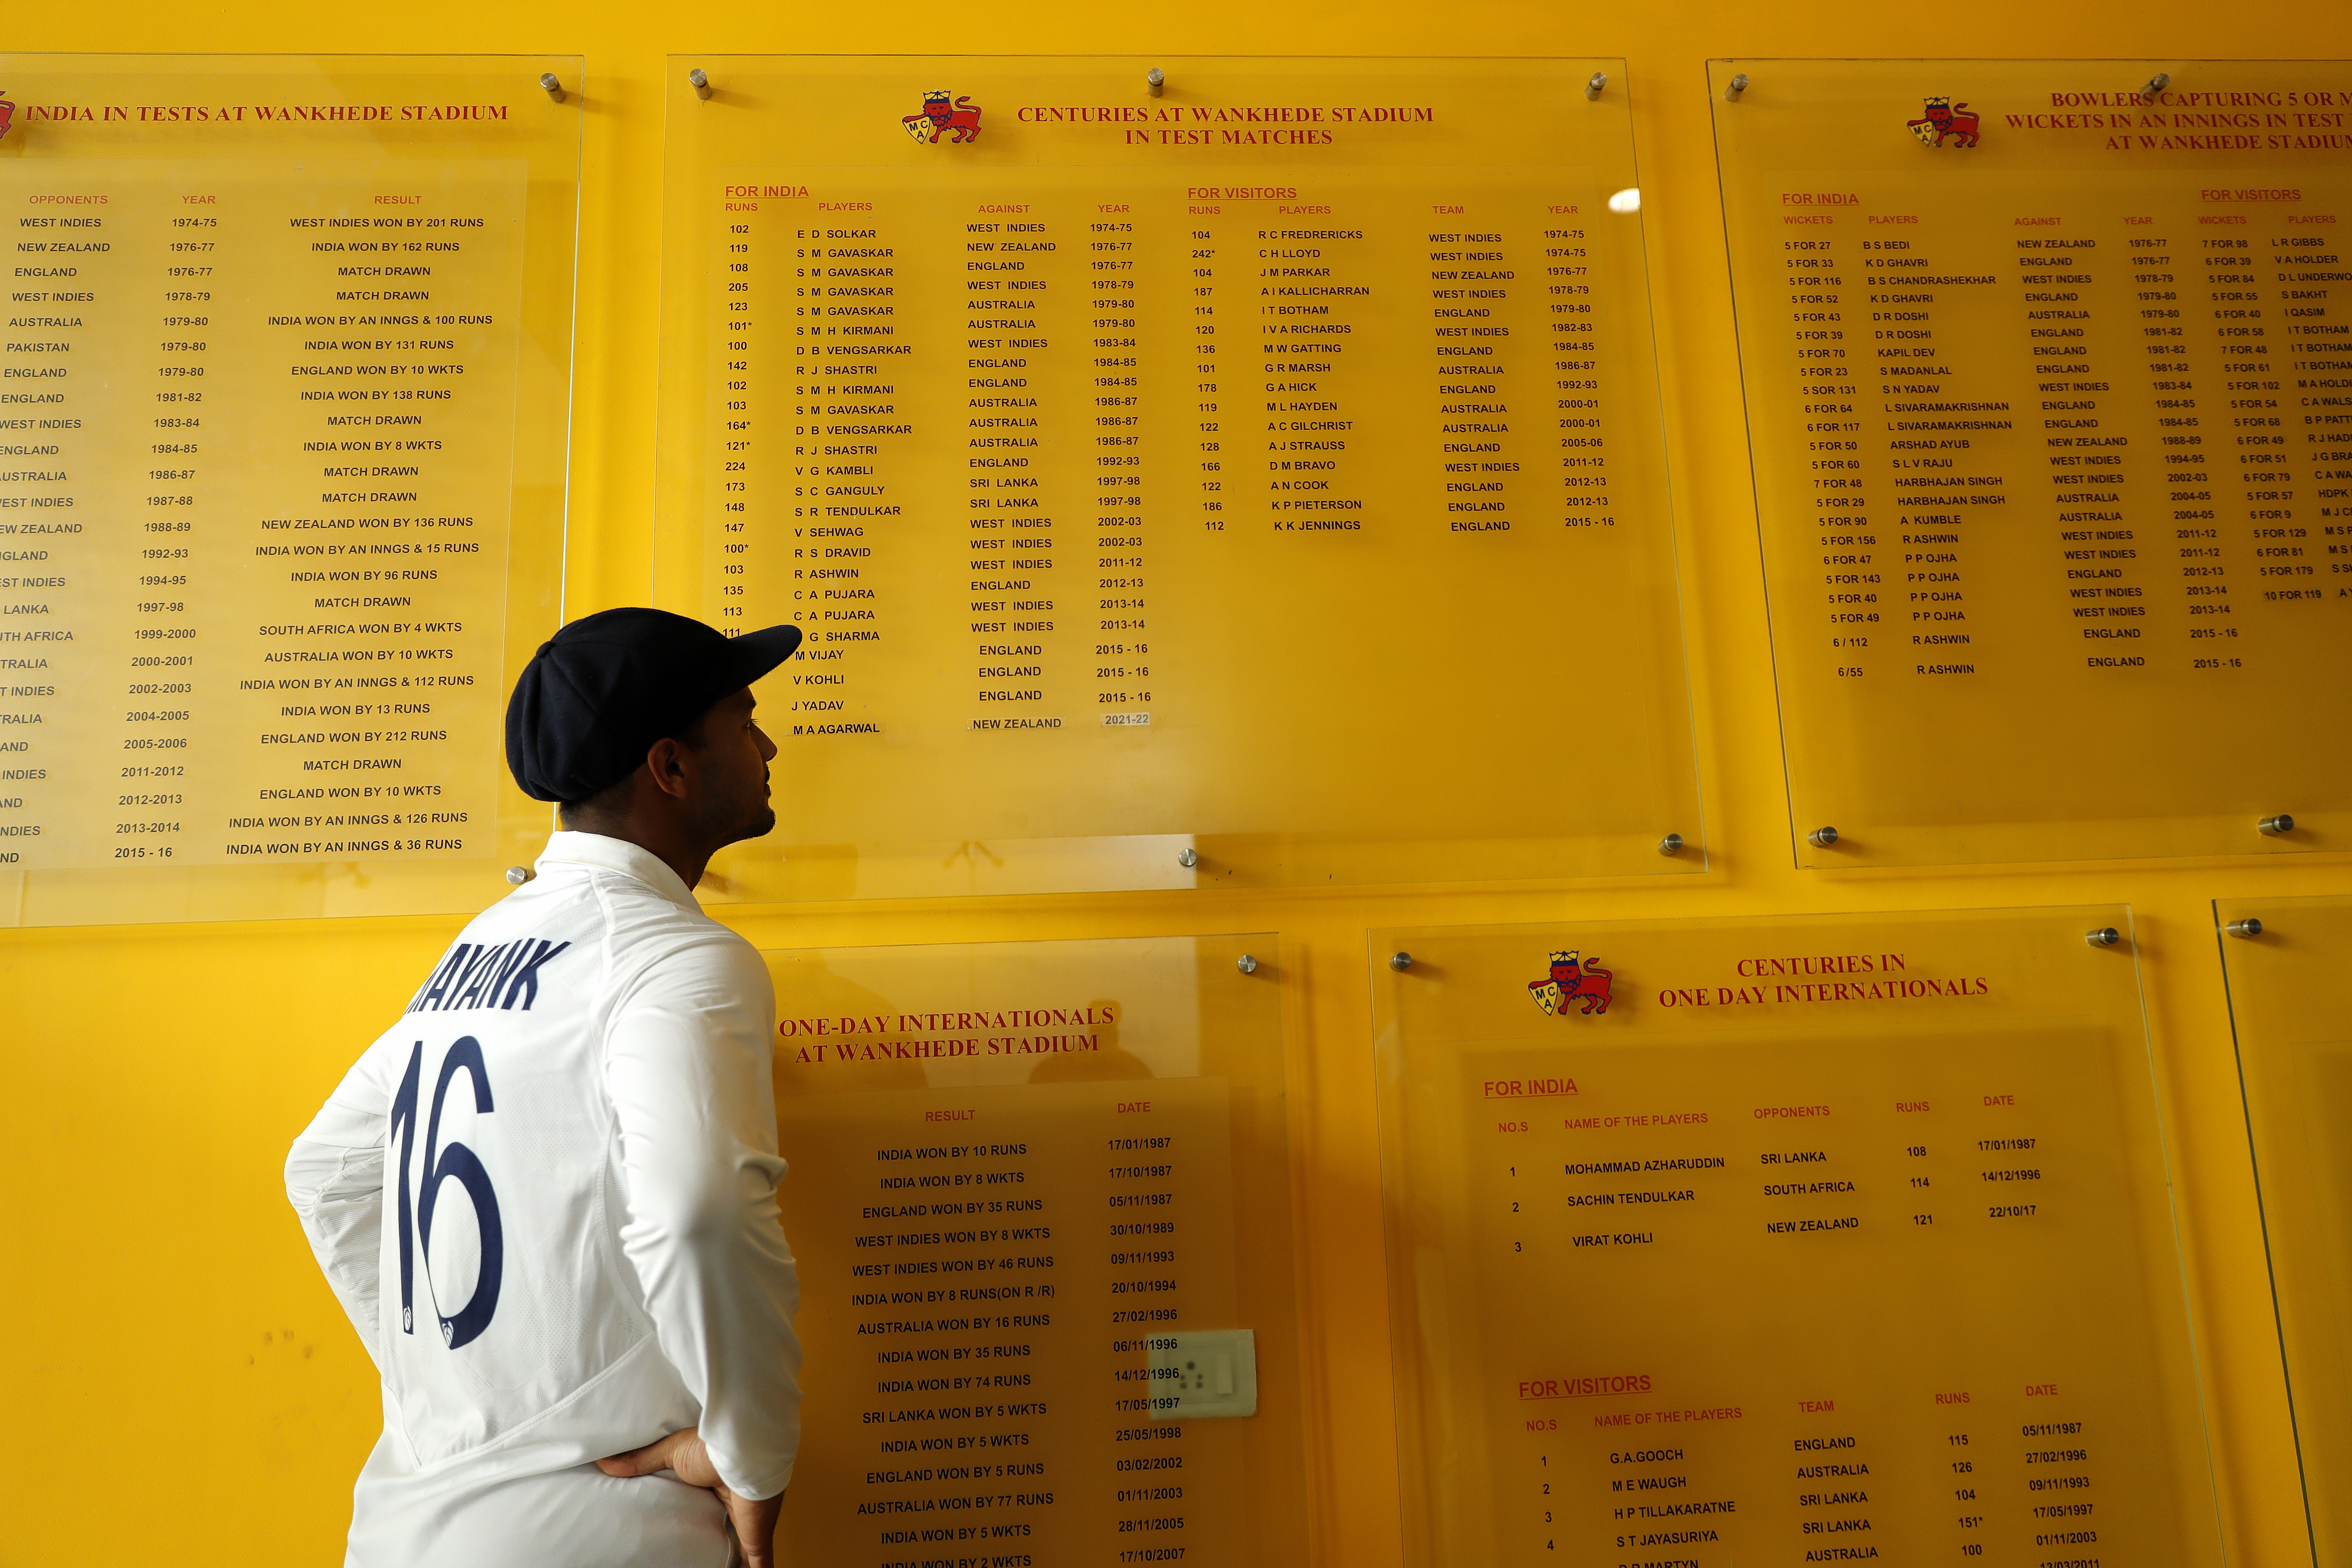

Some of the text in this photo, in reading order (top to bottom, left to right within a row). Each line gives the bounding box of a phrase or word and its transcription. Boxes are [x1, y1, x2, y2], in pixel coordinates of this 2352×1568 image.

[2051, 92, 2154, 106] BOWLERS
[2160, 92, 2282, 106] CAPTURING
[2288, 92, 2298, 106] 5
[2303, 92, 2334, 106] OR
[26, 105, 508, 122] INDIA IN TESTS AT WANKHEDE STADIUM
[1018, 107, 1434, 122] CENTURIES AT WANKHEDE STADIUM
[2005, 113, 2344, 129] WICKETS IN AN INNINGS IN TEST
[1125, 130, 1333, 145] IN TEST MATCHES
[2106, 135, 2132, 150] AT
[2138, 135, 2262, 149] WANKHEDE
[725, 186, 809, 197] FOR INDIA
[1188, 187, 1297, 199] FOR VISITORS
[29, 195, 108, 204] OPPONENTS
[182, 196, 216, 204] YEAR
[374, 196, 422, 204] RESULT
[1782, 193, 1859, 206] FOR INDIA
[725, 203, 758, 211] RUNS
[819, 202, 872, 211] PLAYERS
[978, 205, 1030, 213] AGAINST
[1098, 204, 1130, 213] YEAR
[1189, 206, 1221, 214] RUNS
[1279, 206, 1331, 214] PLAYERS
[1432, 206, 1464, 214] TEAM
[1547, 206, 1578, 214] YEAR
[20, 218, 102, 228] WEST INDIES
[172, 218, 217, 227] 1974-75
[290, 218, 484, 228] WEST INDIES WON BY 201 RUNS
[1783, 216, 1833, 224] WICKETS
[1869, 215, 1918, 224] PLAYERS
[730, 224, 749, 234] 102
[966, 224, 1045, 232] WEST INDIES
[1090, 223, 1132, 232] 1974-75
[797, 229, 876, 238] E D SOLKAR
[1191, 231, 1211, 239] 104
[1258, 230, 1363, 239] R C FREDRERICKS
[1259, 249, 1320, 258] C H LLOYD
[1789, 277, 1842, 286] 5 FOR 116
[1868, 276, 1997, 285] B S CHANDRASHEKHAR
[2134, 274, 2174, 283] 1978-79
[796, 326, 893, 336] S M H KIRMANI
[1802, 385, 1856, 395] 5 SOR 131
[1882, 385, 1940, 394] S N YADAV
[725, 502, 745, 512] 148
[970, 498, 1039, 508] SRI LANKA
[1202, 502, 1222, 511] 186
[1272, 500, 1362, 510] K P PIETERSON
[794, 506, 901, 517] S R TENDULKAR
[134, 629, 196, 639] 1999-2000
[259, 622, 462, 636] SOUTH AFRICA WON BY 4 WKTS
[973, 718, 1061, 729] NEW ZEALAND
[1106, 714, 1148, 724] 2021-22
[793, 723, 880, 735] M A AGARWAL
[260, 785, 441, 799] ENGLAND WON BY 10 WKTS
[118, 794, 182, 805] 2012-2013
[1737, 954, 1905, 977] CENTURIES IN
[1659, 977, 1988, 1008] ONE DAY INTERNATIONALS
[779, 1007, 1114, 1037] ONE-DAY INTERNATIONALS
[795, 1034, 1099, 1063] AT WANKHEDE STADIUM
[1484, 1078, 1578, 1096] FOR INDIA
[1117, 1102, 1151, 1113] DATE
[925, 1110, 976, 1122] RESULT
[1978, 1138, 2036, 1151] 17/01/1987
[1907, 1146, 1927, 1157] 108
[1760, 1151, 1827, 1165] SRI LANKA
[1565, 1157, 1725, 1175] MOHAMMAD AZHARUDDIN
[391, 1035, 504, 1350] 16
[1110, 1222, 1174, 1236] 30/10/1989
[855, 1227, 1050, 1248] WEST INDIES WON BY 8 WKTS
[1572, 1232, 1653, 1247] VIRAT KOHLI
[2022, 1422, 2082, 1437] 05/11/1987
[1794, 1437, 1856, 1451] ENGLAND
[1610, 1449, 1684, 1464] G.A.GOOCH
